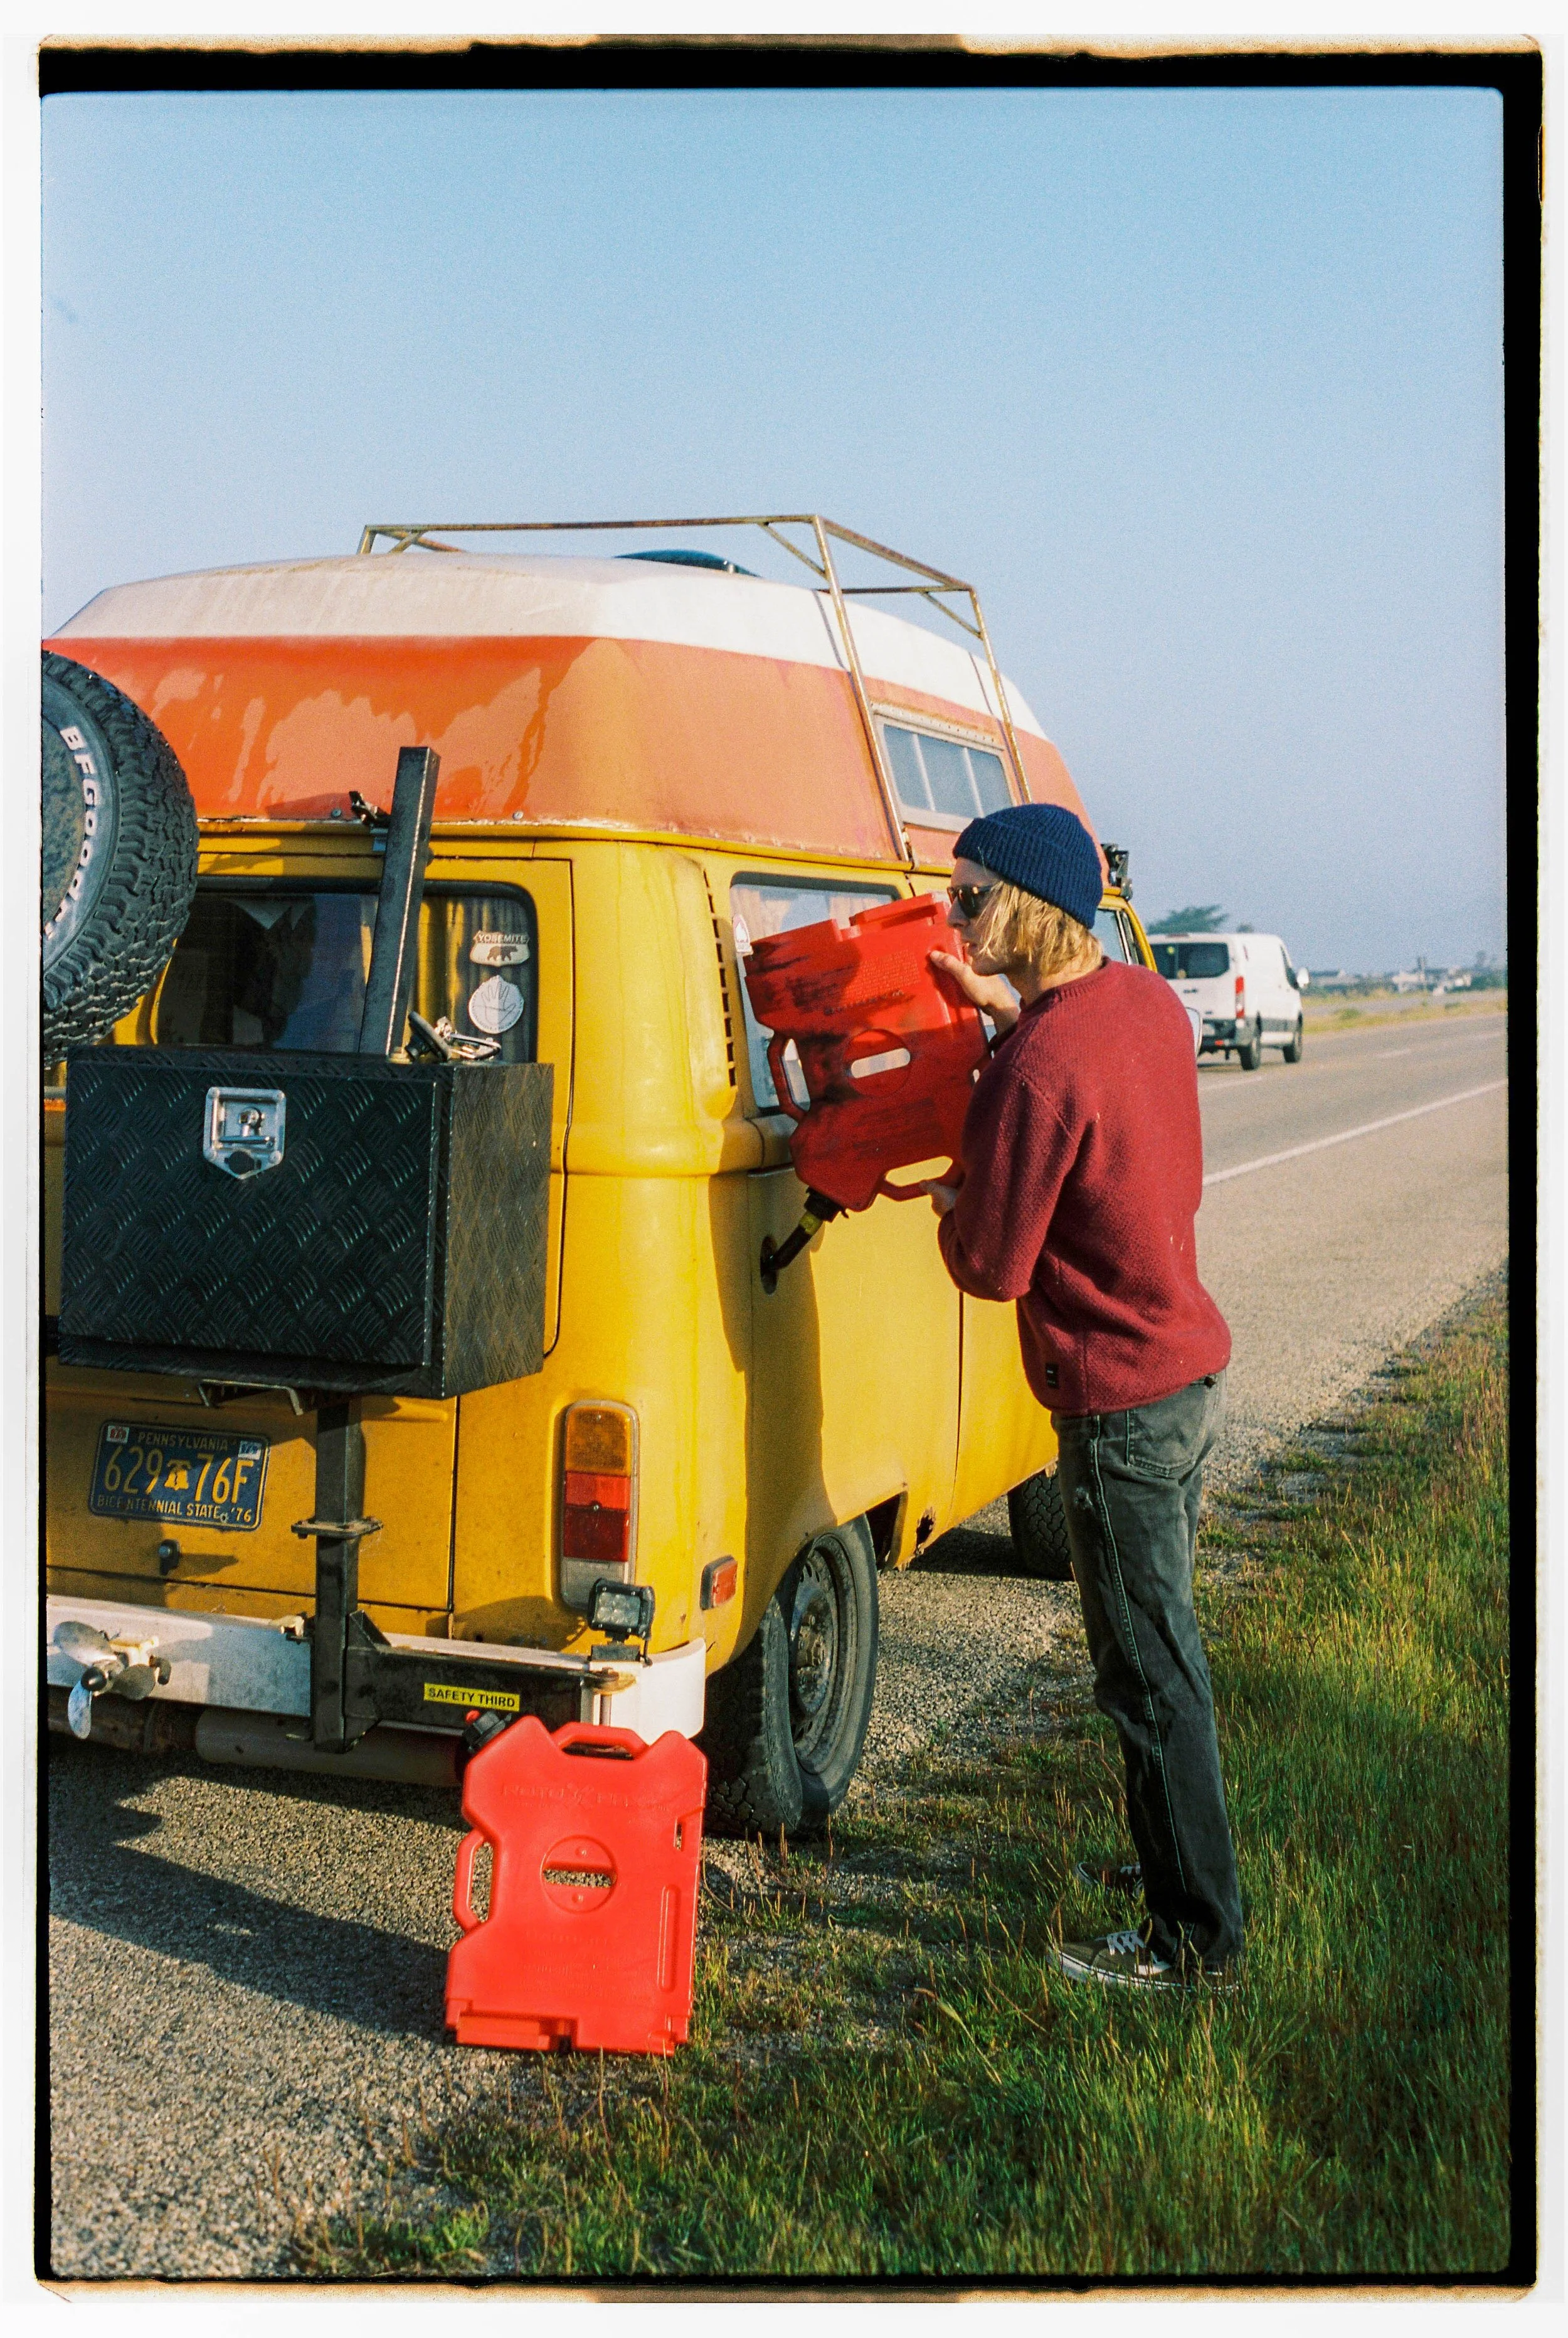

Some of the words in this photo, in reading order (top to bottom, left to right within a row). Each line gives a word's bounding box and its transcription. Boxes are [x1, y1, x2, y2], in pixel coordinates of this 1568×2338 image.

[478, 933, 527, 943] YOSEMITE
[137, 1432, 228, 1450] PENNSYLVANIA
[103, 1445, 163, 1495] 629
[194, 1453, 254, 1504] 76F
[186, 1504, 221, 1519] STATE
[230, 1507, 252, 1522] '76
[429, 1687, 475, 1702] SAFETY
[479, 1694, 515, 1708] THIRD
